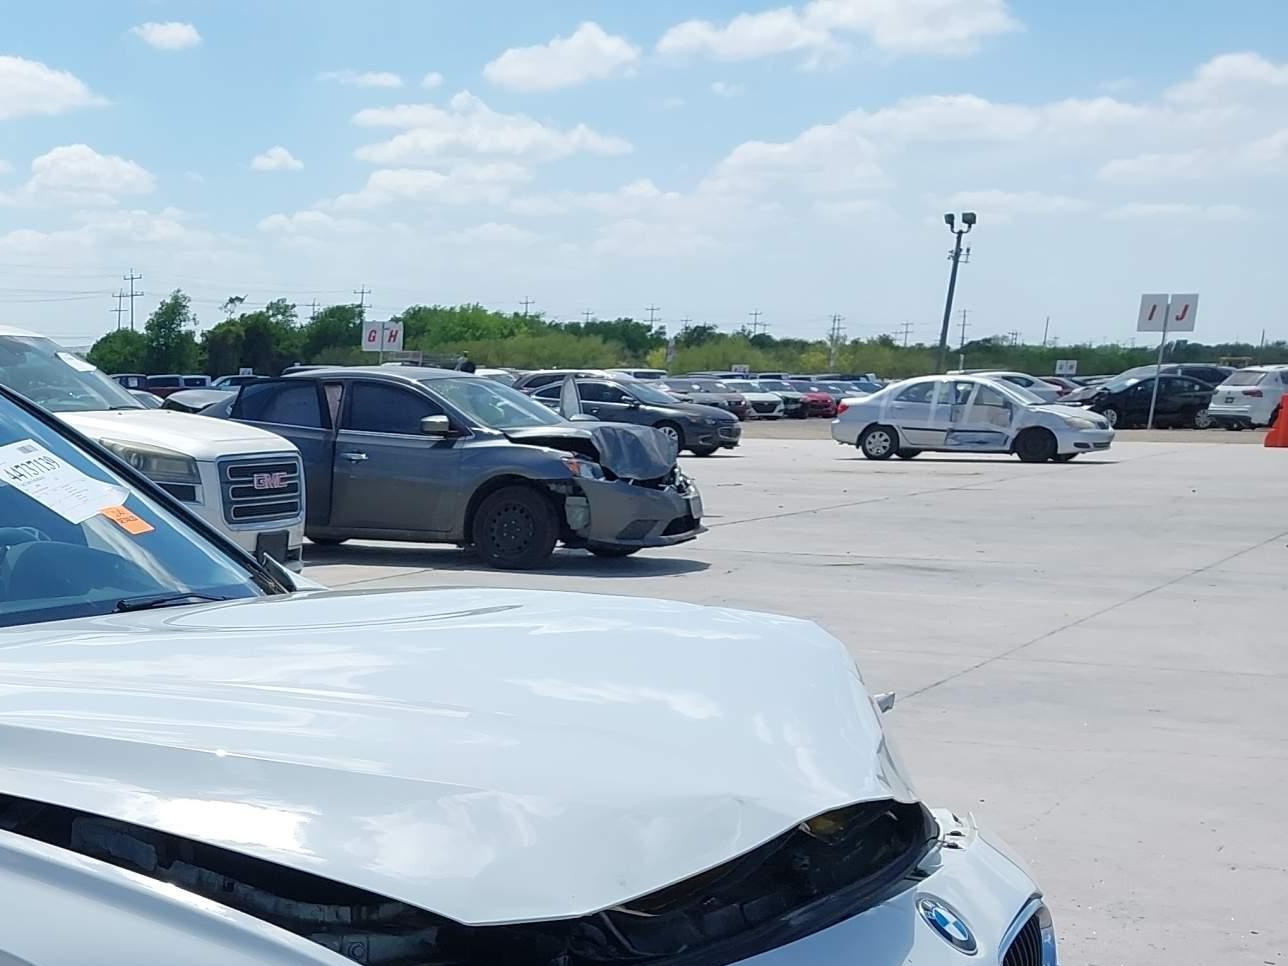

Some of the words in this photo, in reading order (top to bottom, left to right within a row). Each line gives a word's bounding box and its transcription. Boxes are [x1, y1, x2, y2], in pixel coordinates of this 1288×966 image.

[1175, 304, 1190, 321] J
[367, 329, 377, 342] G
[387, 329, 399, 343] H
[3, 456, 62, 482] 44737139
[253, 472, 288, 489] GMC
